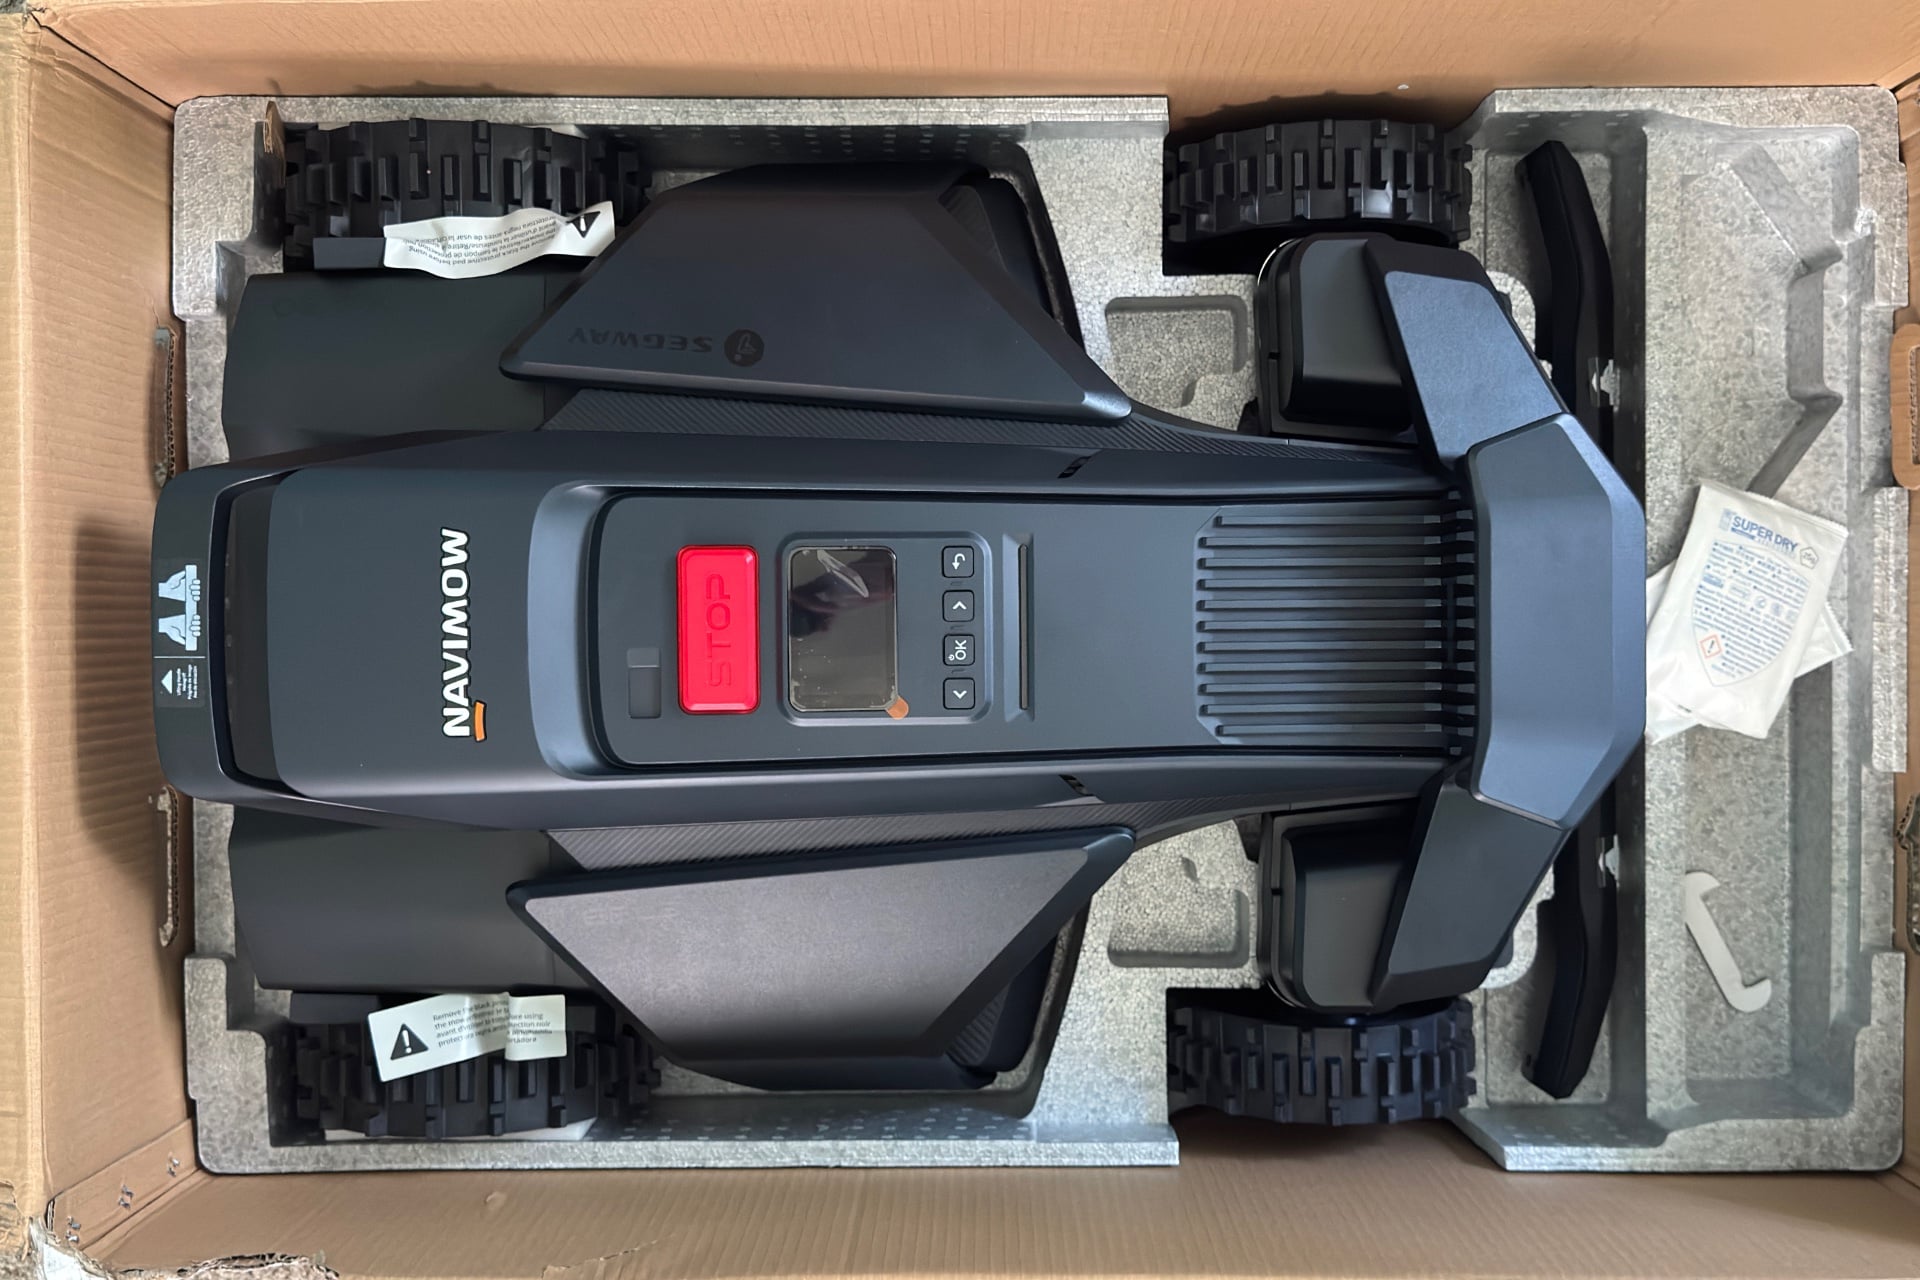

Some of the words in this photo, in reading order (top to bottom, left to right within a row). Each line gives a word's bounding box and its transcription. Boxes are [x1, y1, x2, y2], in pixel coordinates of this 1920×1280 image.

[473, 235, 483, 243] de
[408, 246, 428, 257] using
[467, 251, 501, 265] protective
[428, 253, 451, 266] before
[452, 257, 466, 266] pad
[567, 328, 713, 353] SEGWAY
[1732, 515, 1774, 541] SUPER
[1774, 533, 1799, 552] DRY
[441, 527, 470, 738] NAVIMOW
[705, 573, 732, 687] STOP
[954, 639, 967, 661] OK
[433, 1009, 461, 1022] Remove
[524, 1012, 544, 1020] using
[434, 1022, 447, 1030] the
[436, 1028, 456, 1038] avant
